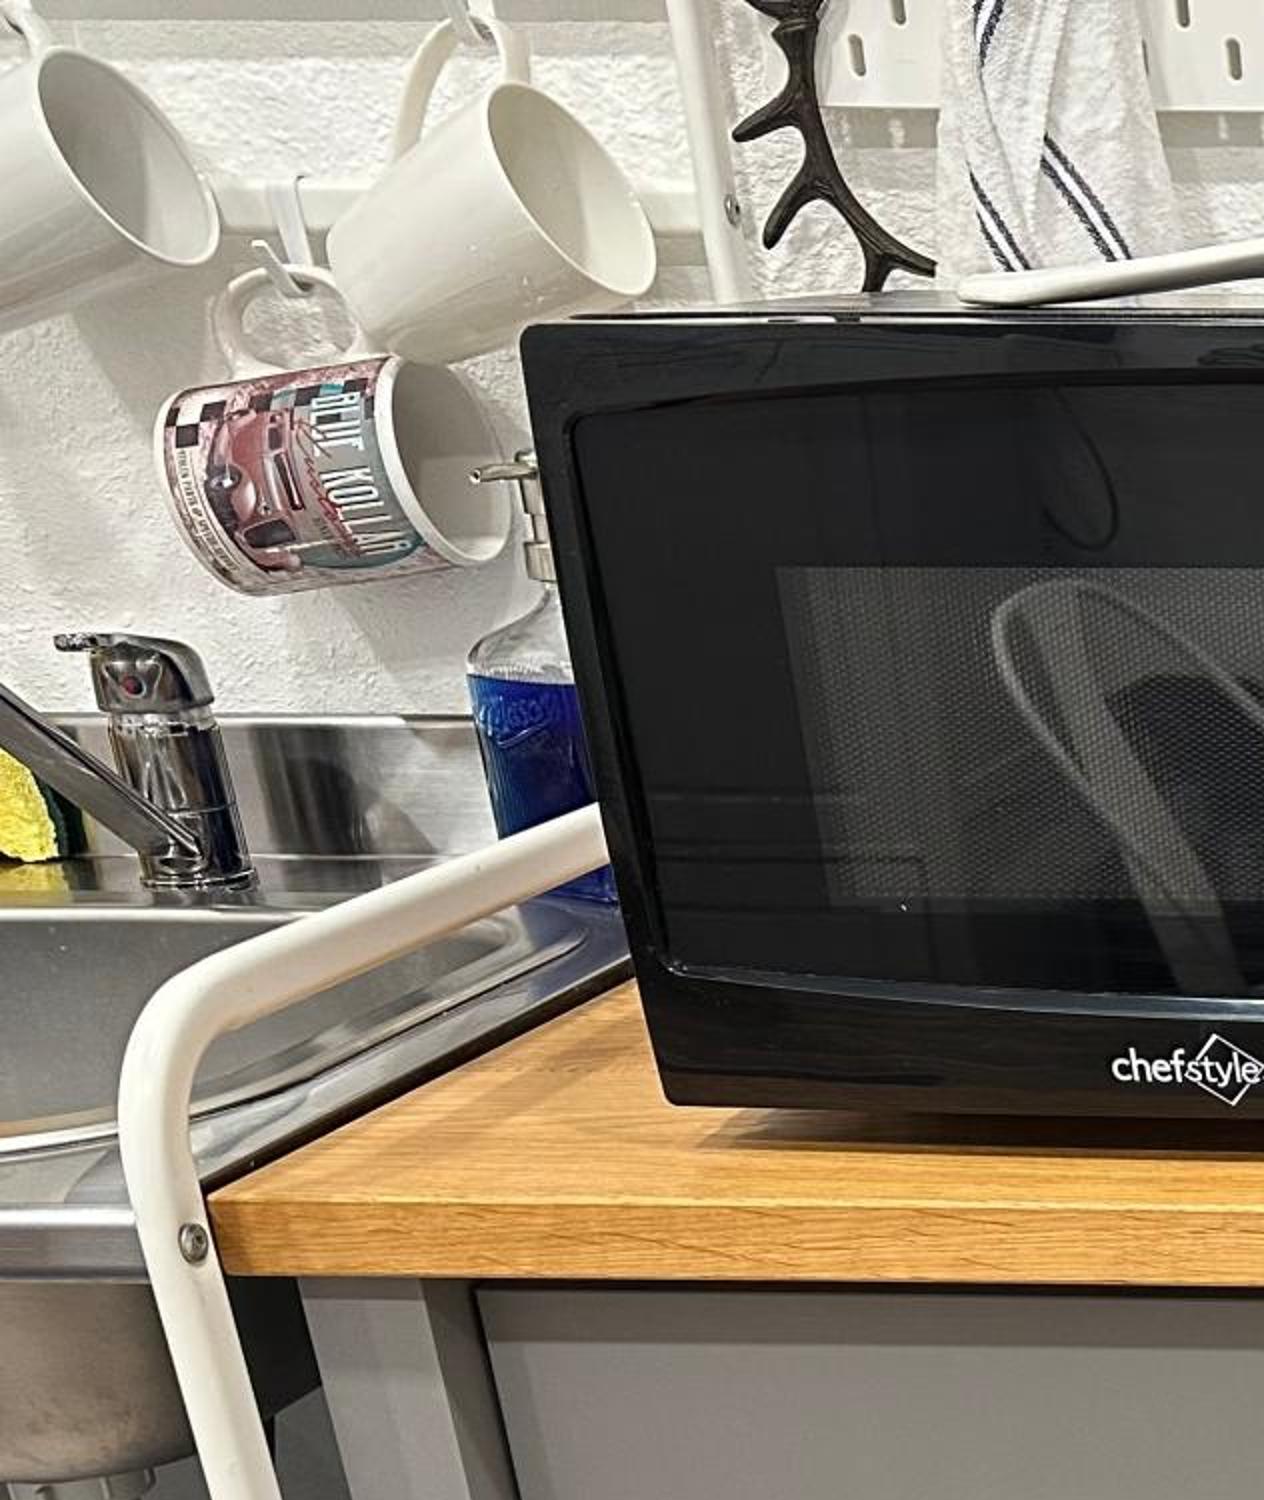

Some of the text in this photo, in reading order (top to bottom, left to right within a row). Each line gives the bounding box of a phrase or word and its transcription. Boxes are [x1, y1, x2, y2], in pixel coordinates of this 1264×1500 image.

[311, 391, 365, 457] BLUE
[319, 465, 412, 556] KOLLAR
[1111, 1047, 1260, 1088] chefstyle
